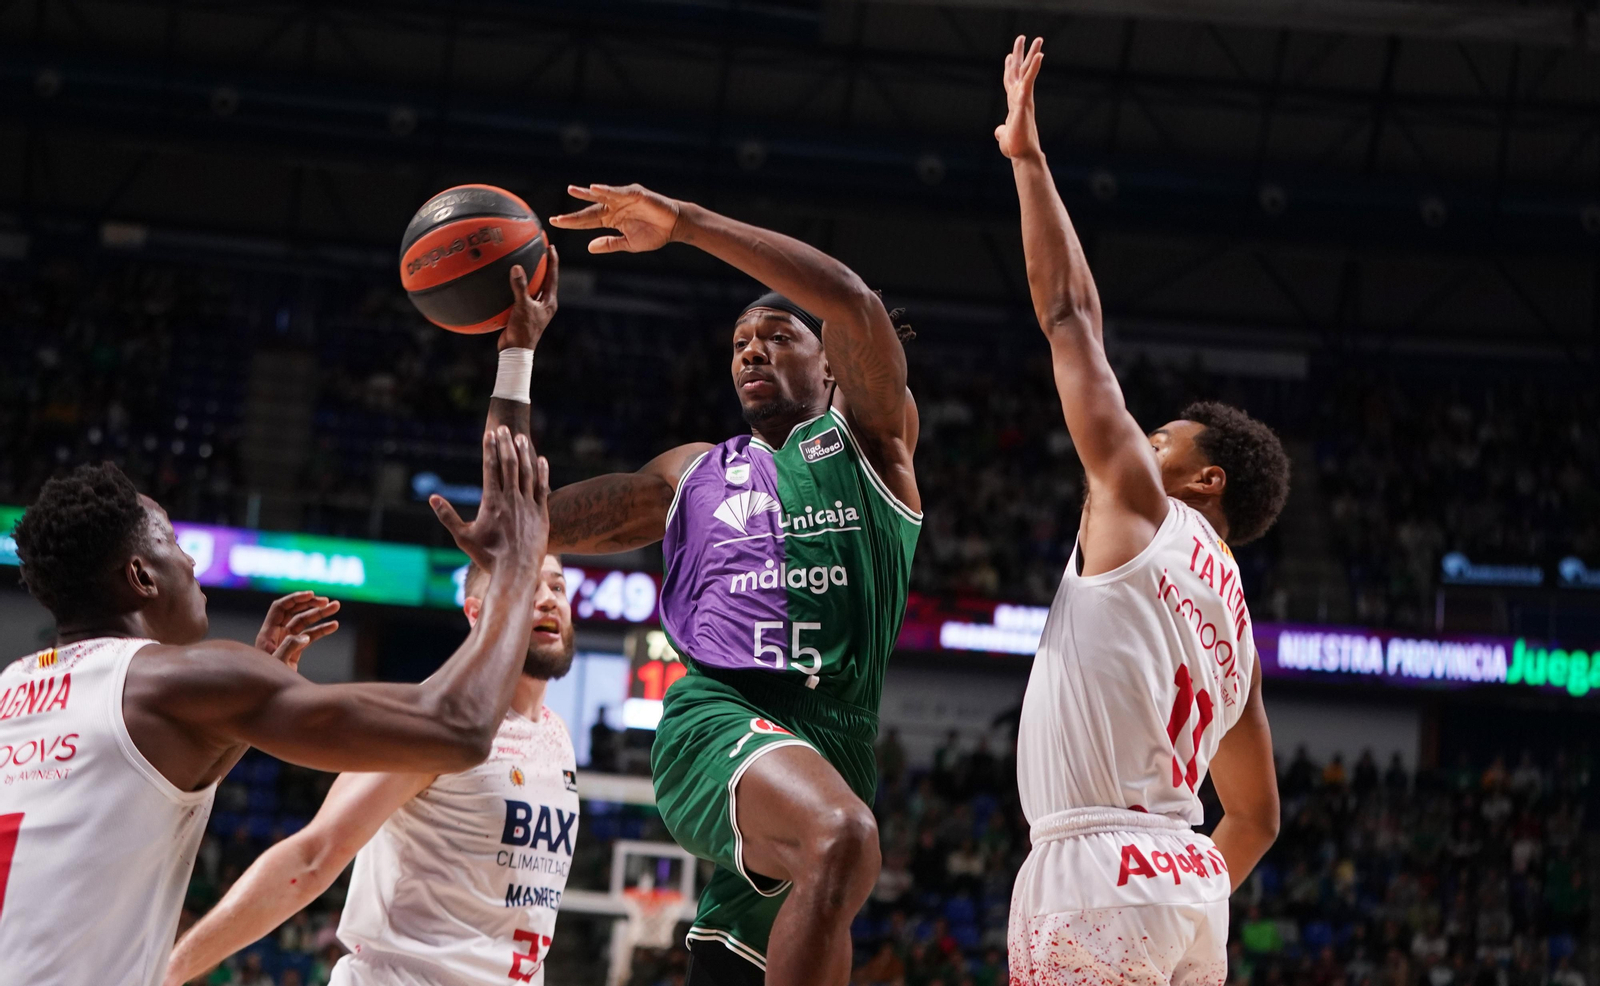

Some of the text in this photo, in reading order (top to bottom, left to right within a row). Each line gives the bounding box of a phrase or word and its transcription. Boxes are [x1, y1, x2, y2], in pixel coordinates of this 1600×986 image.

[805, 443, 821, 454] liga
[777, 500, 860, 531] Unicaja
[753, 620, 823, 676] 55
[1278, 631, 1384, 675] NUESTRA
[1387, 637, 1507, 683] PROVINCIA
[18, 768, 73, 780] AVINENT
[501, 799, 577, 857] BAX
